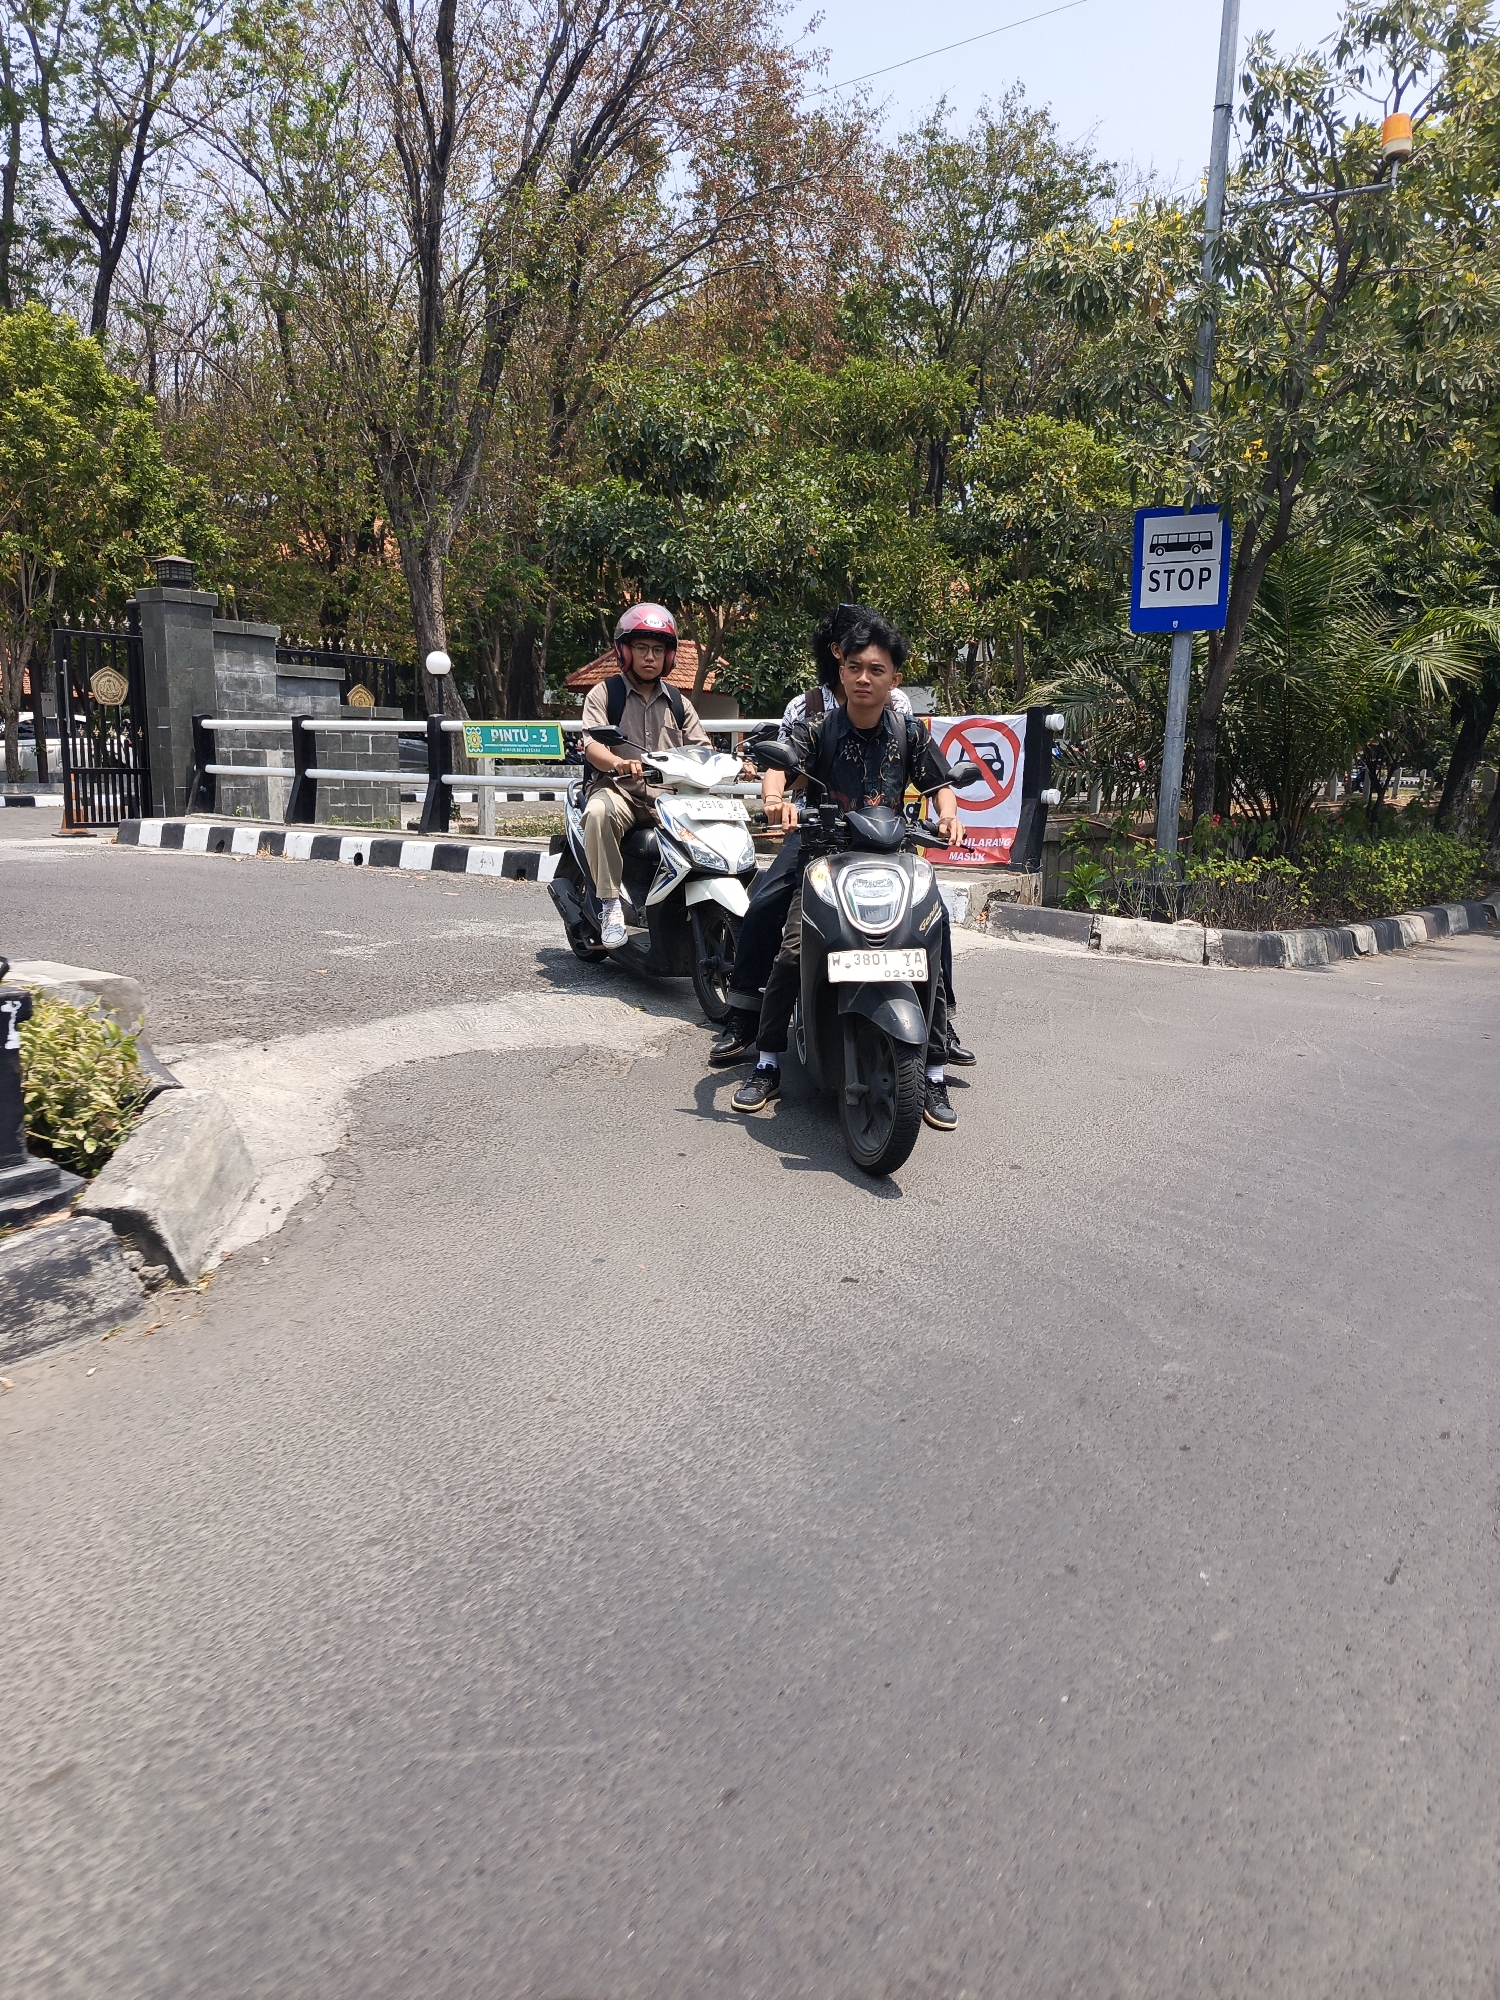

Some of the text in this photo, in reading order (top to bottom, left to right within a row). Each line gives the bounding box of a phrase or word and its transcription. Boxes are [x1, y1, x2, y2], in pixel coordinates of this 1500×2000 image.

[1148, 567, 1212, 592] STOP
[491, 729, 528, 742] PINTU
[539, 729, 548, 742] 3
[948, 851, 986, 862] MASUK
[853, 953, 888, 966] 3801
[901, 951, 923, 965] YA
